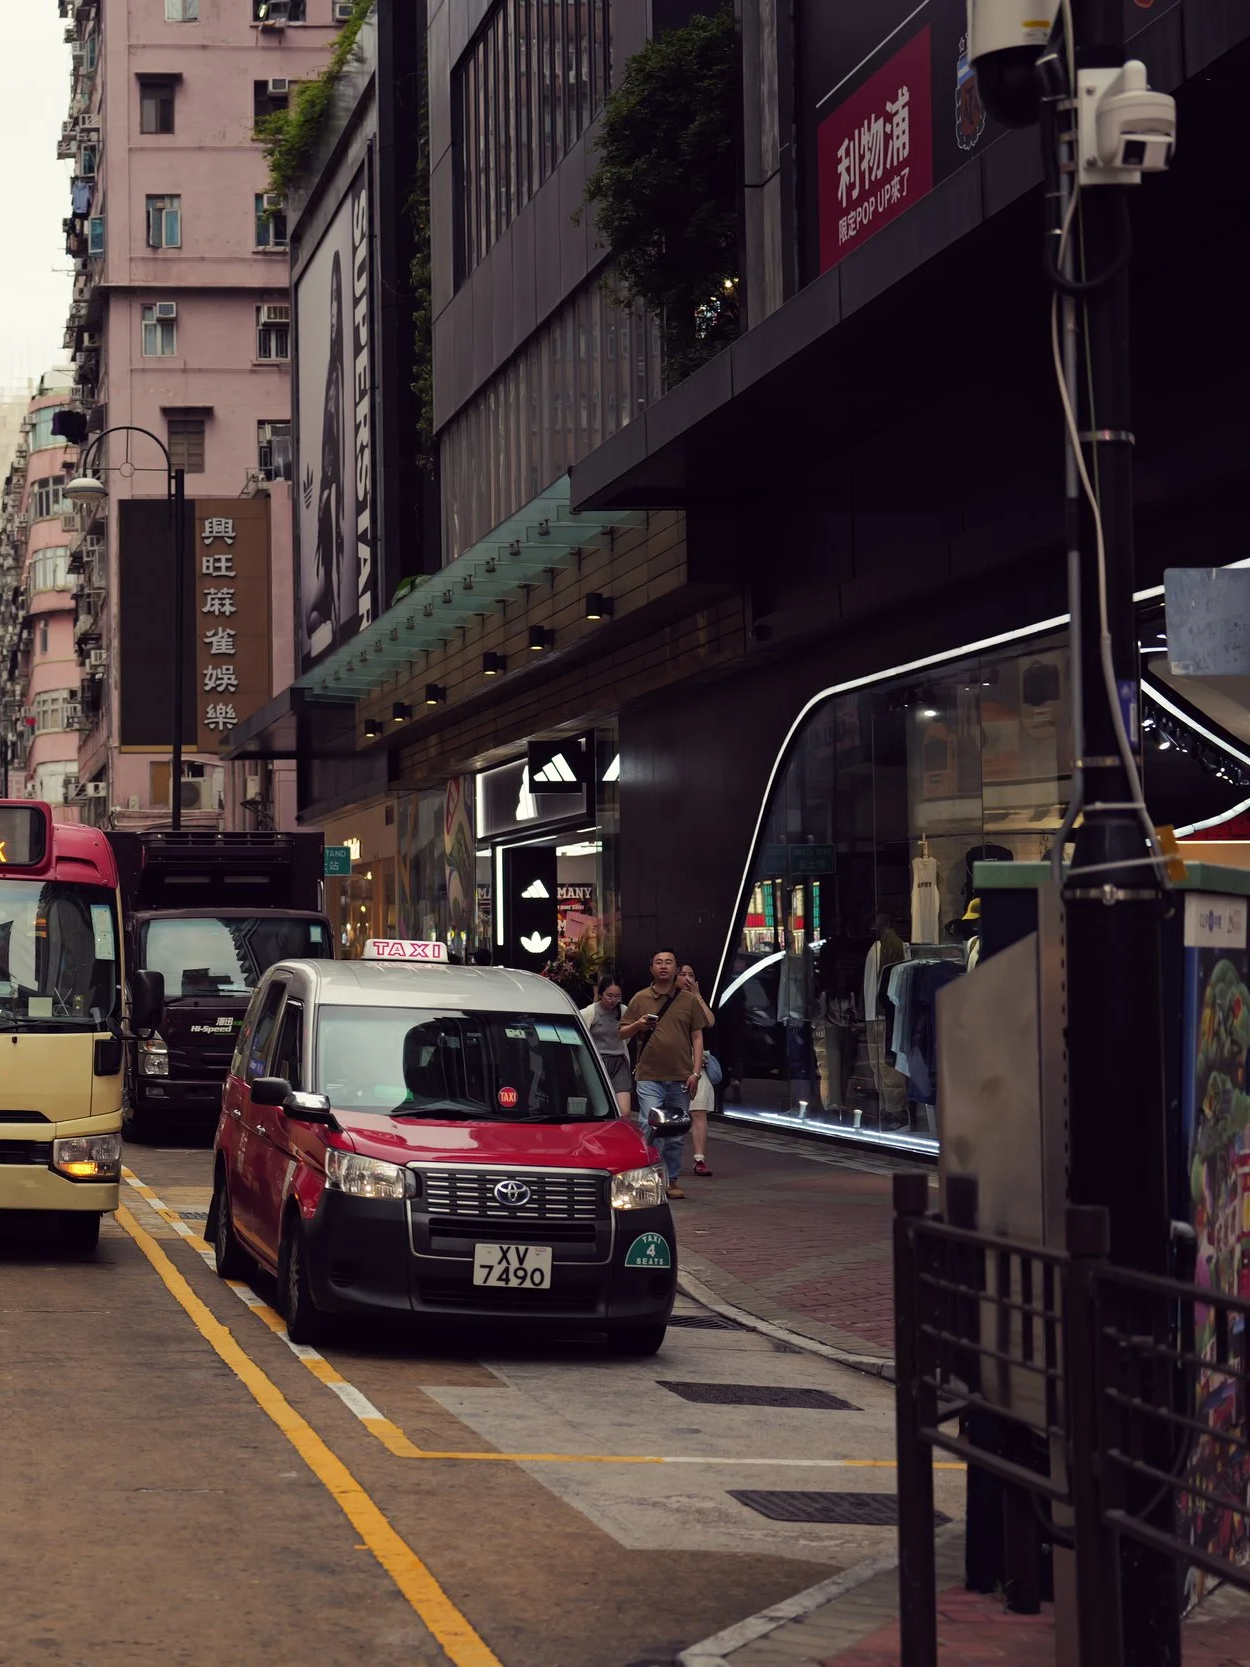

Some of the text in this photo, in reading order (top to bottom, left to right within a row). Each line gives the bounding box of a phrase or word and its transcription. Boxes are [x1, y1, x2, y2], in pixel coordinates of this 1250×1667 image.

[836, 85, 910, 209] 利物浦
[352, 187, 372, 632] SUPERSTAR
[557, 886, 592, 899] MANY
[373, 940, 442, 959] TAXI
[191, 1025, 232, 1034] Hi-Speed
[500, 1091, 517, 1105] TAXI
[642, 1235, 661, 1244] TAXI
[497, 1246, 530, 1266] XV
[646, 1243, 656, 1257] 4
[636, 1257, 664, 1265] SEATS
[479, 1265, 546, 1288] 7490
